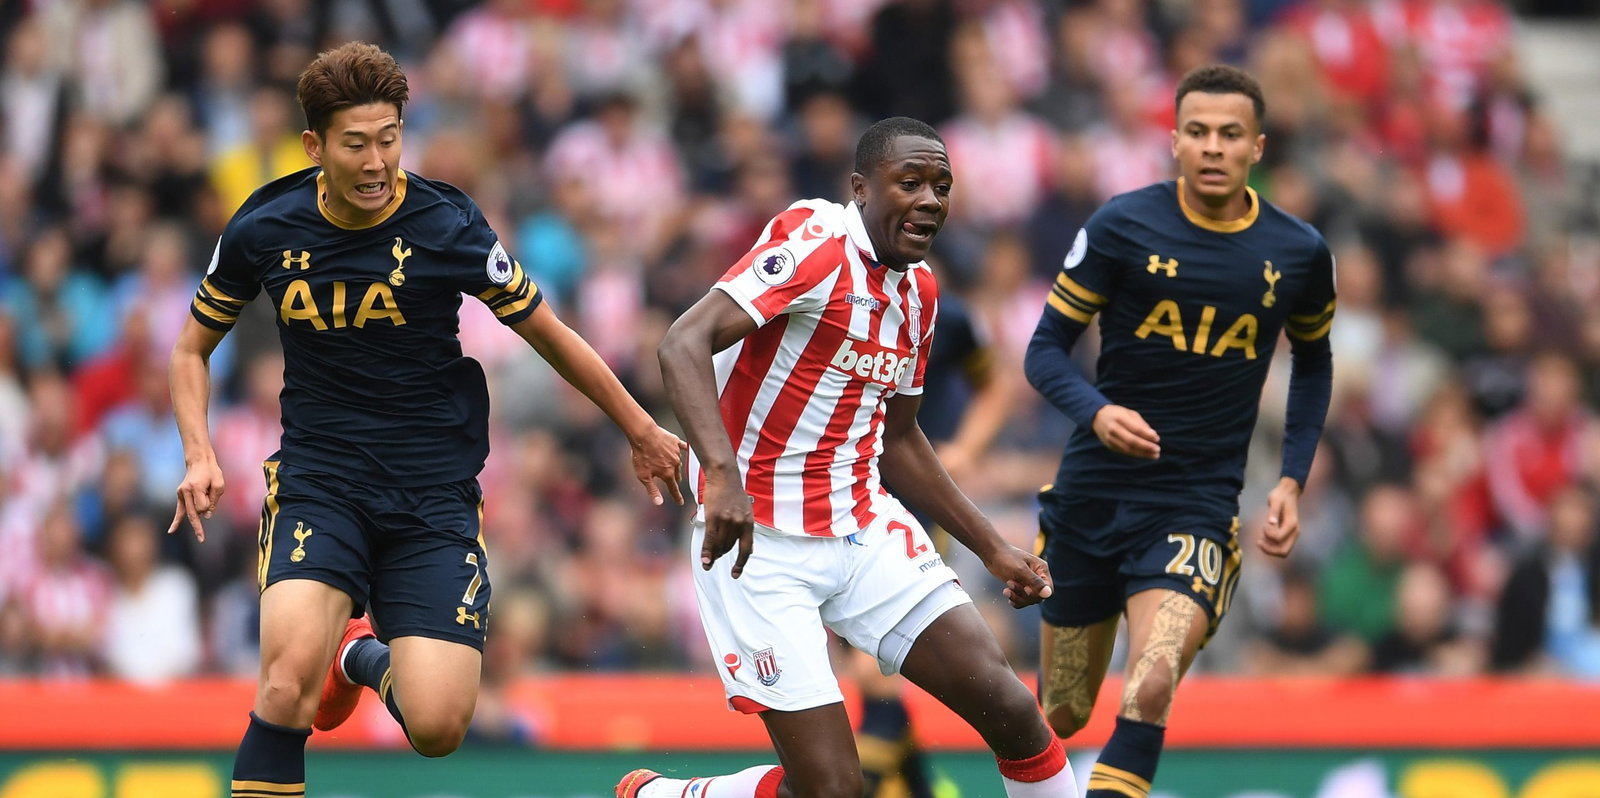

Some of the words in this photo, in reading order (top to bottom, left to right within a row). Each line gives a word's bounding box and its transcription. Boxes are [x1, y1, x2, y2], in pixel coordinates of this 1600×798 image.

[280, 279, 407, 331] AIA
[845, 293, 881, 311] macron
[1134, 299, 1257, 360] AIA
[830, 339, 910, 385] bet36
[886, 519, 928, 560] 2
[1165, 533, 1223, 585] 20
[462, 552, 482, 606] 7
